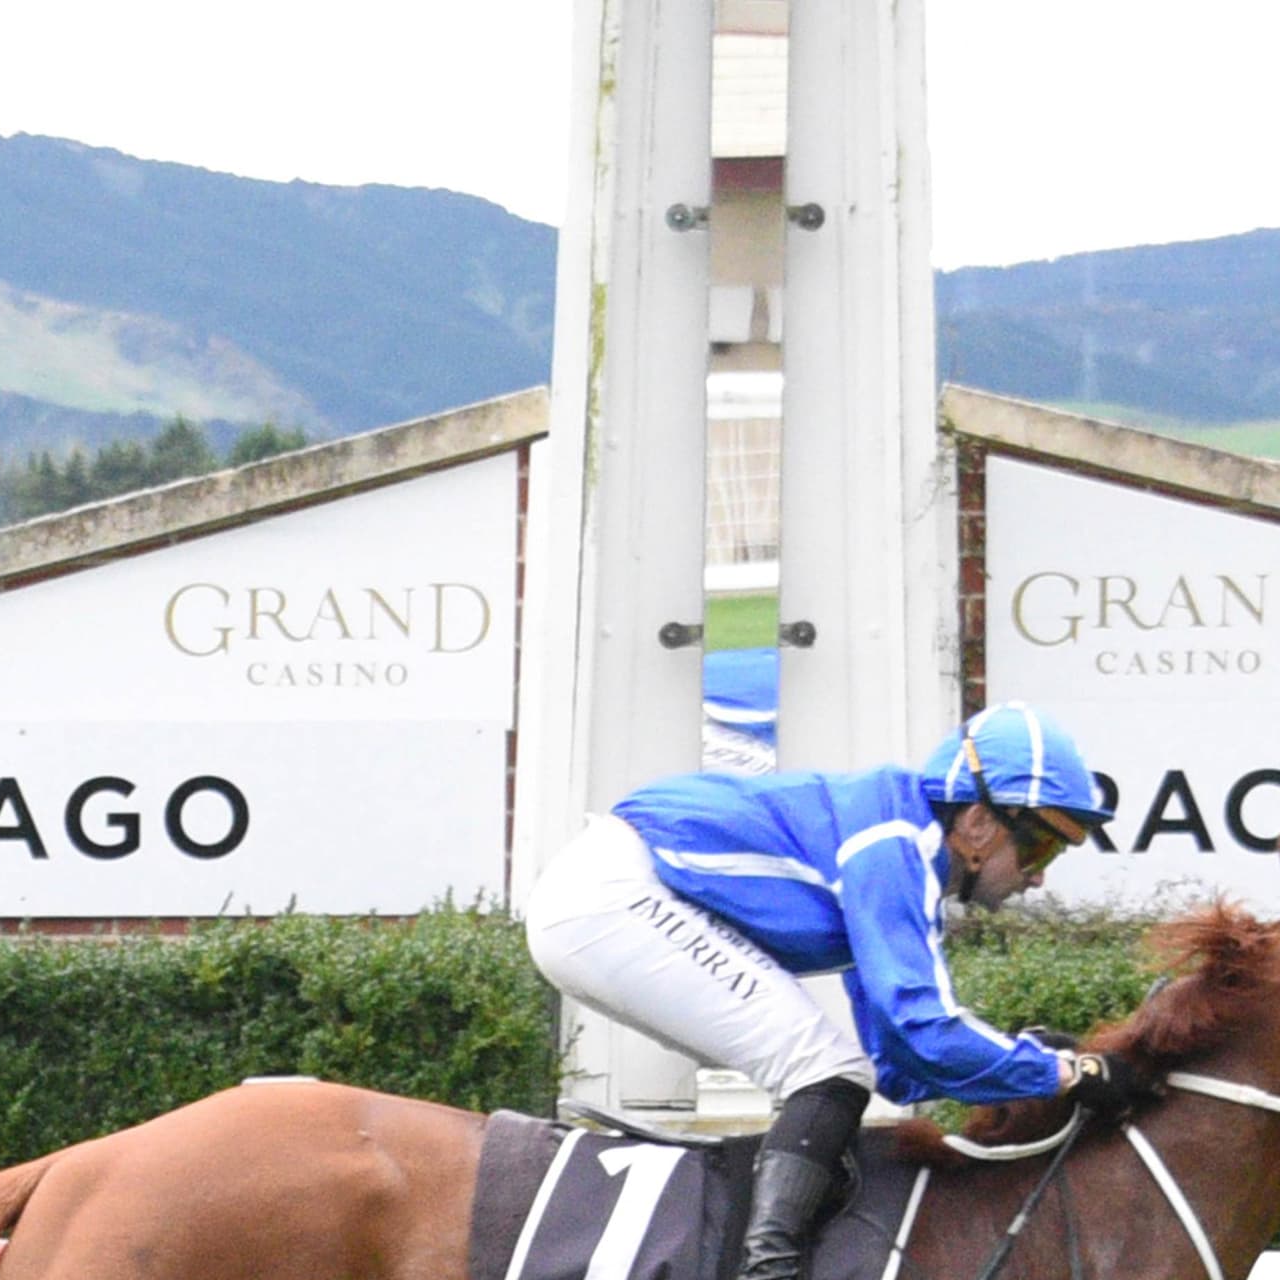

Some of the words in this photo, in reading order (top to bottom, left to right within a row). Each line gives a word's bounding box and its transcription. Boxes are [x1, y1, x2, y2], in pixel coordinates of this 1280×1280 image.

[163, 582, 491, 657] GRAND
[246, 663, 409, 687] CASINO
[1094, 650, 1262, 675] CASINO
